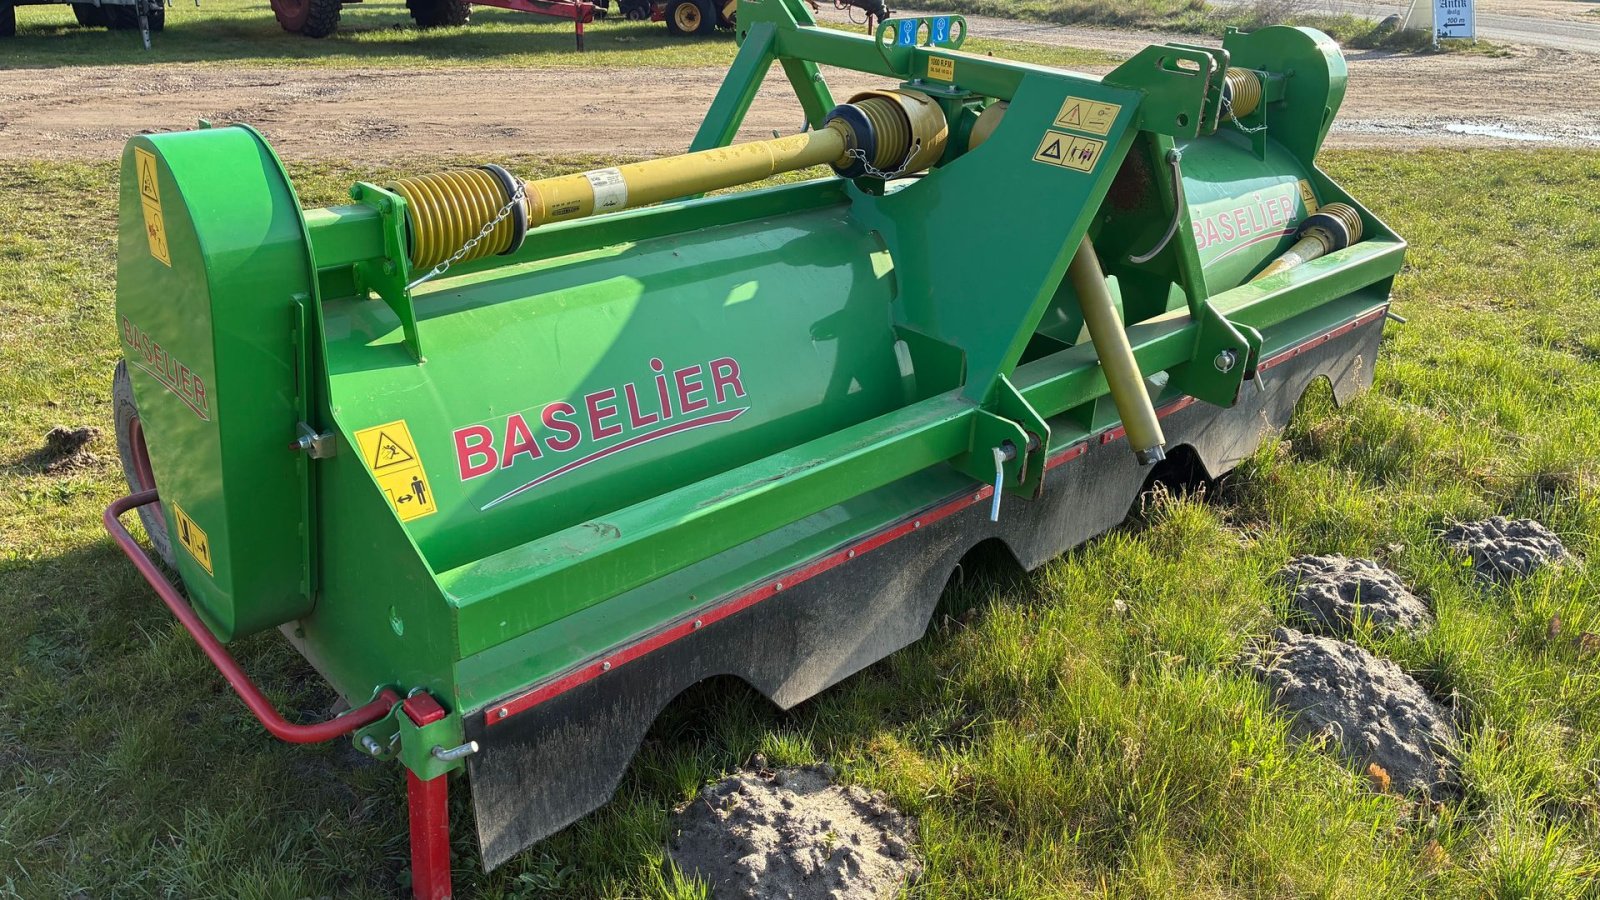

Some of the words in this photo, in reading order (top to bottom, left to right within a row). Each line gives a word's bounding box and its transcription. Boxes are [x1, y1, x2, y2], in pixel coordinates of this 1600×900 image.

[1192, 193, 1296, 250] BASELIER
[122, 314, 208, 411] BASELIER
[452, 357, 746, 482] BASELIER
